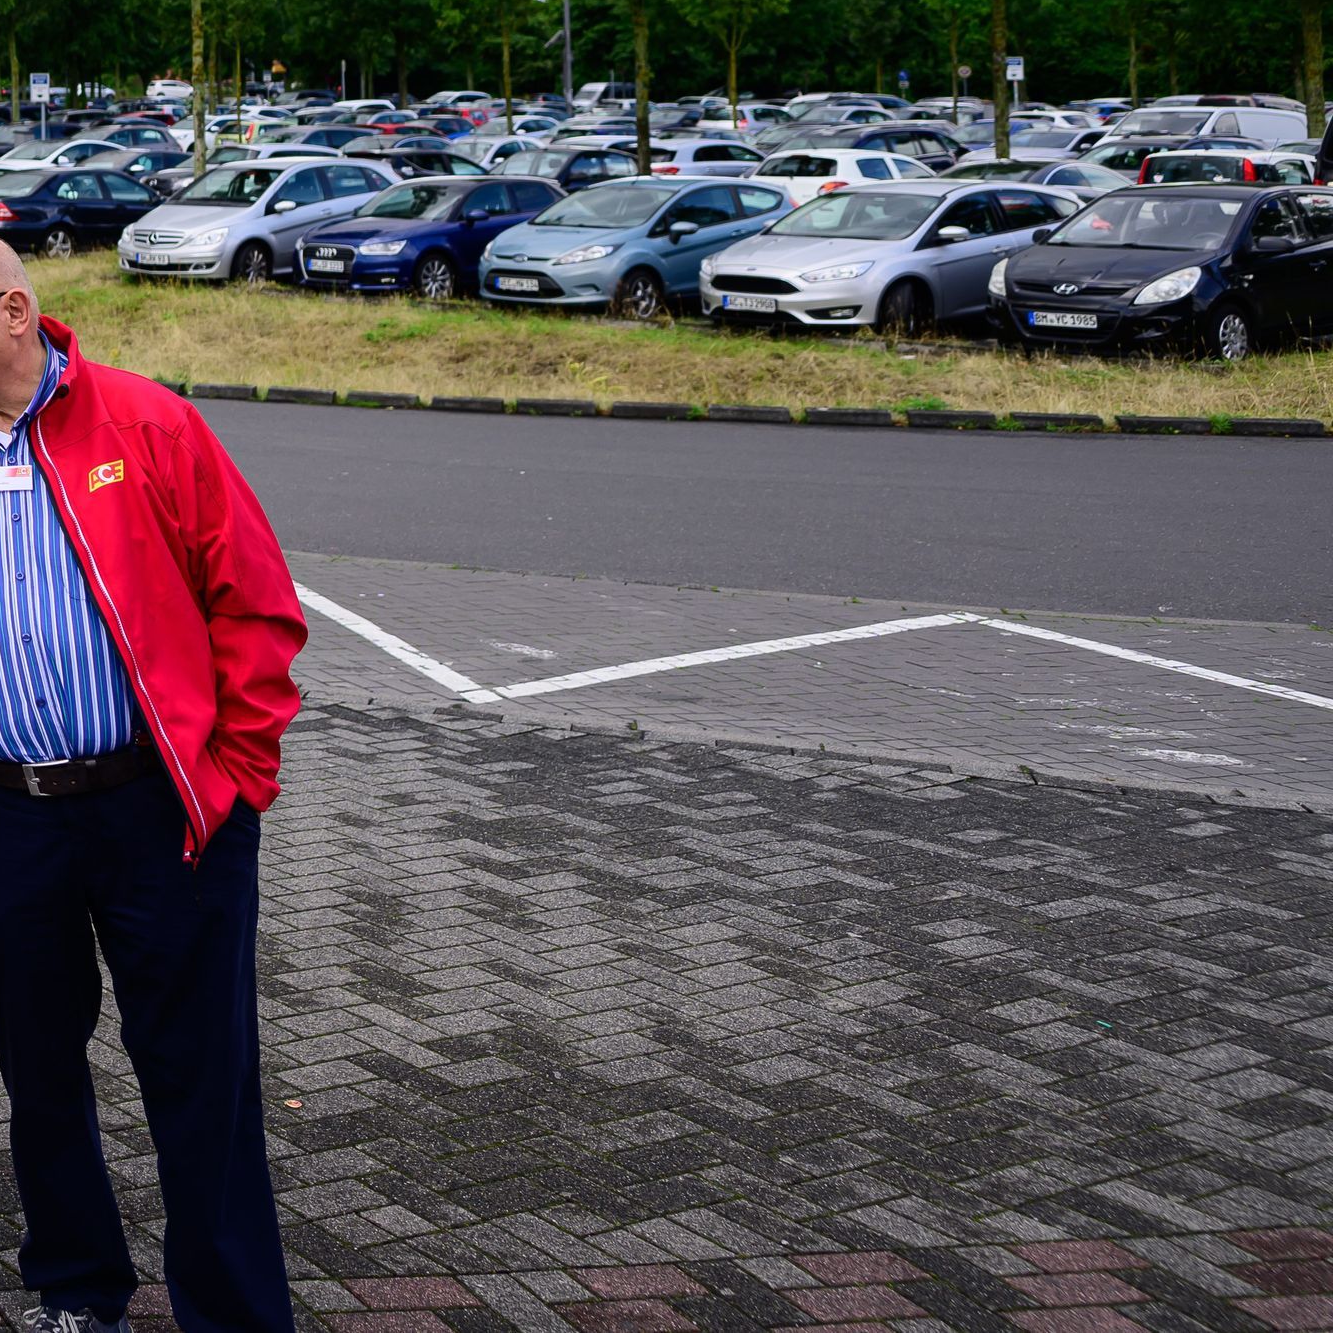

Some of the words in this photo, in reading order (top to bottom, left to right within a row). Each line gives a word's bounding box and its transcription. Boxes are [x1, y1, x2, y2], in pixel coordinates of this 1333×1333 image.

[1035, 312, 1048, 323] BM
[1055, 313, 1068, 325] YC
[1070, 314, 1096, 326] 1985
[90, 463, 124, 491] ACE
